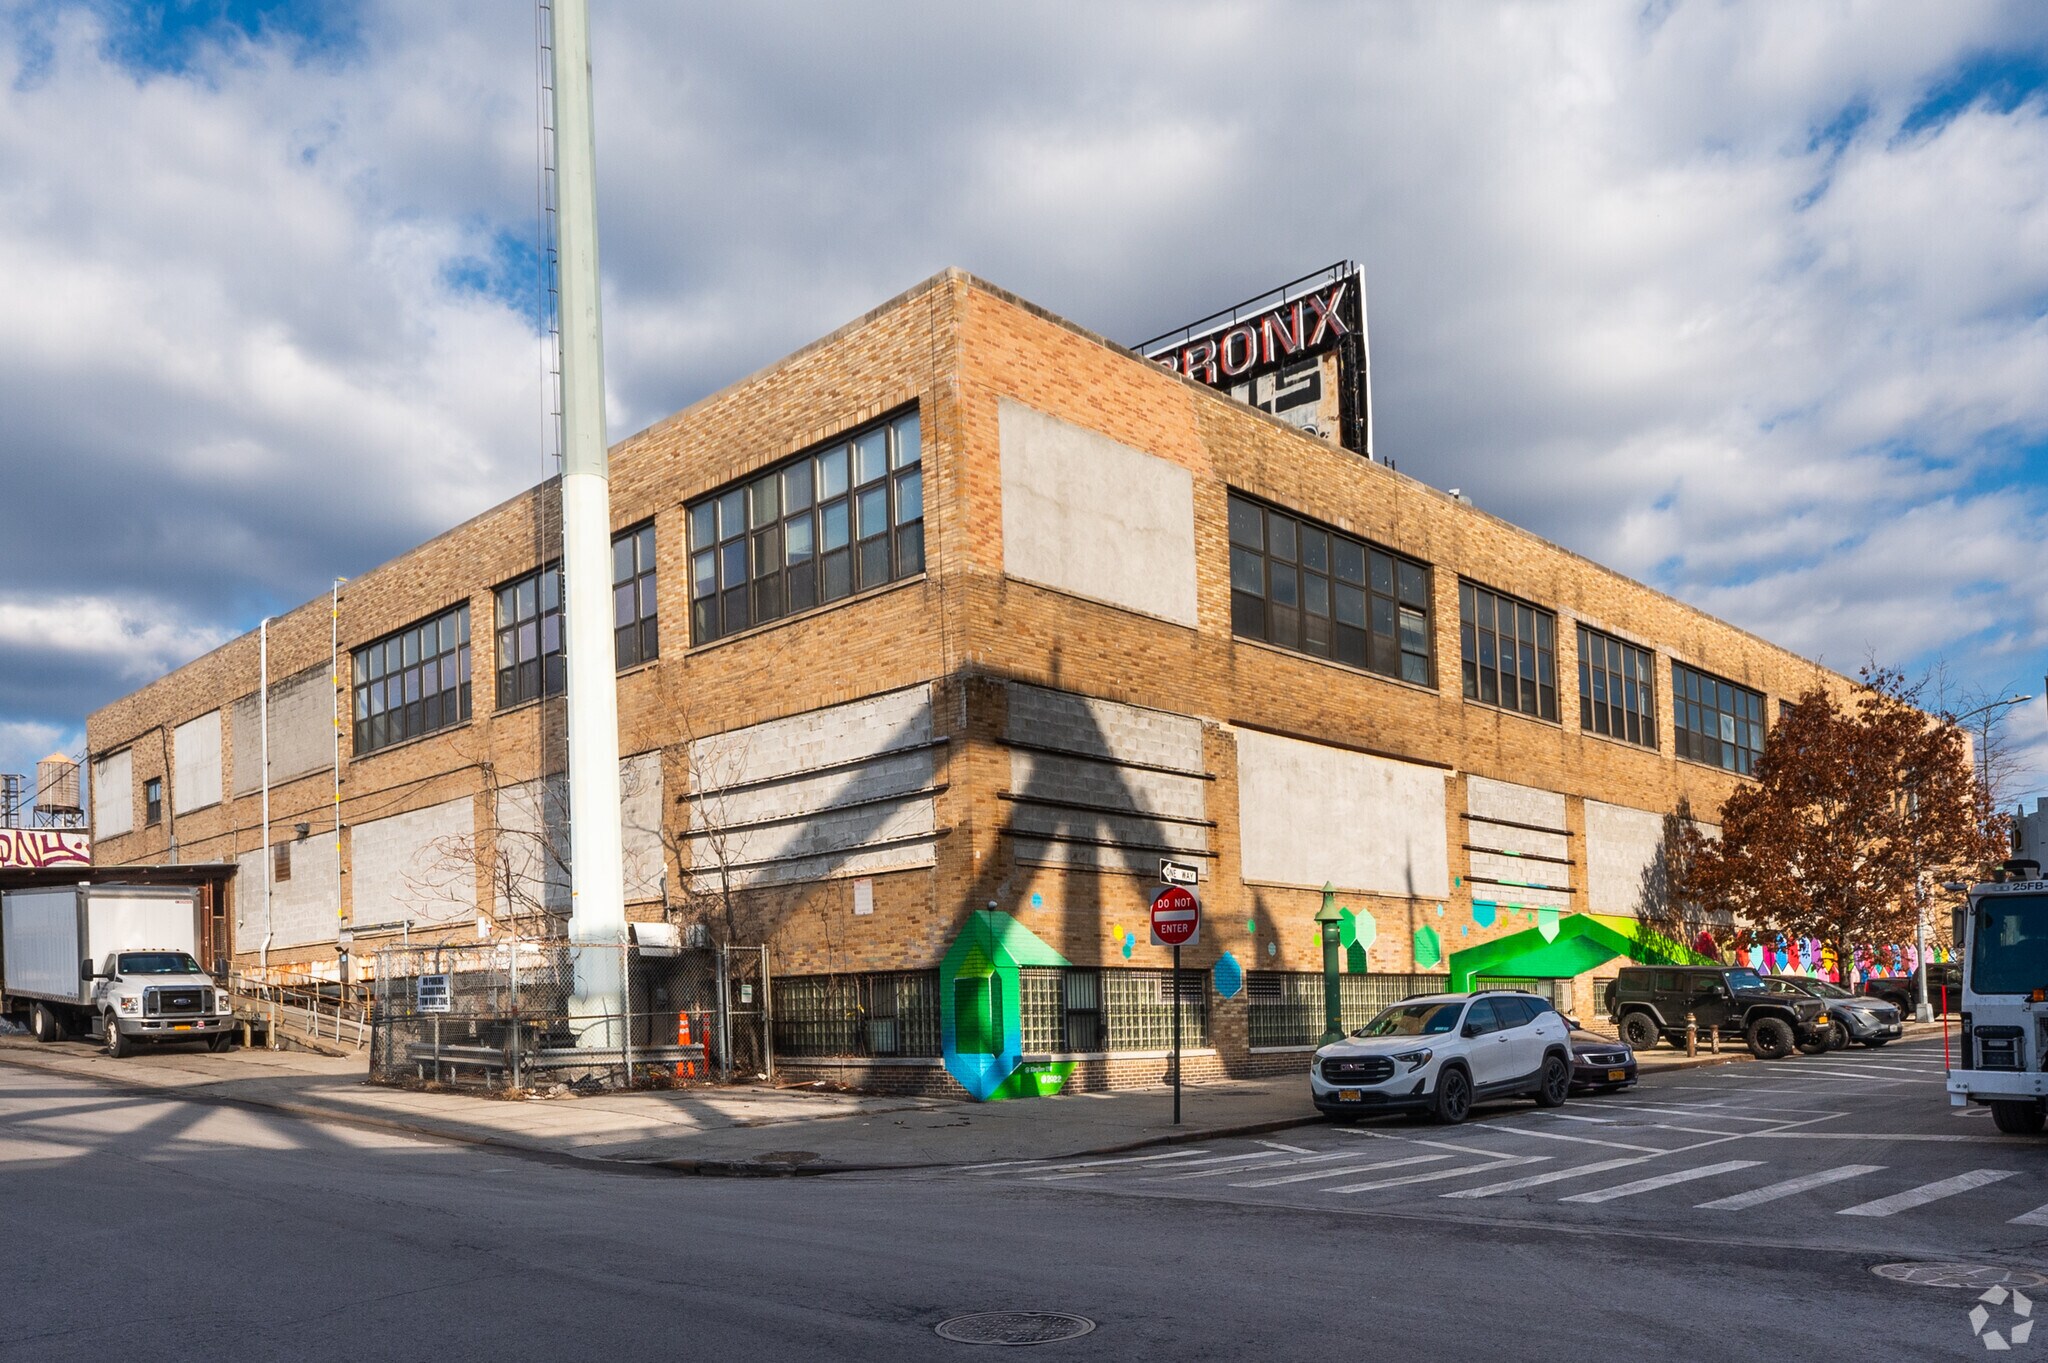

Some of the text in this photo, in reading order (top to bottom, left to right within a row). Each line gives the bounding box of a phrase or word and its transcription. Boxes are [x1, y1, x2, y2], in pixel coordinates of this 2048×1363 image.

[1166, 867, 1194, 880] ONE WAY
[1158, 898, 1191, 908] DO NOT
[1161, 924, 1188, 933] ENTER
